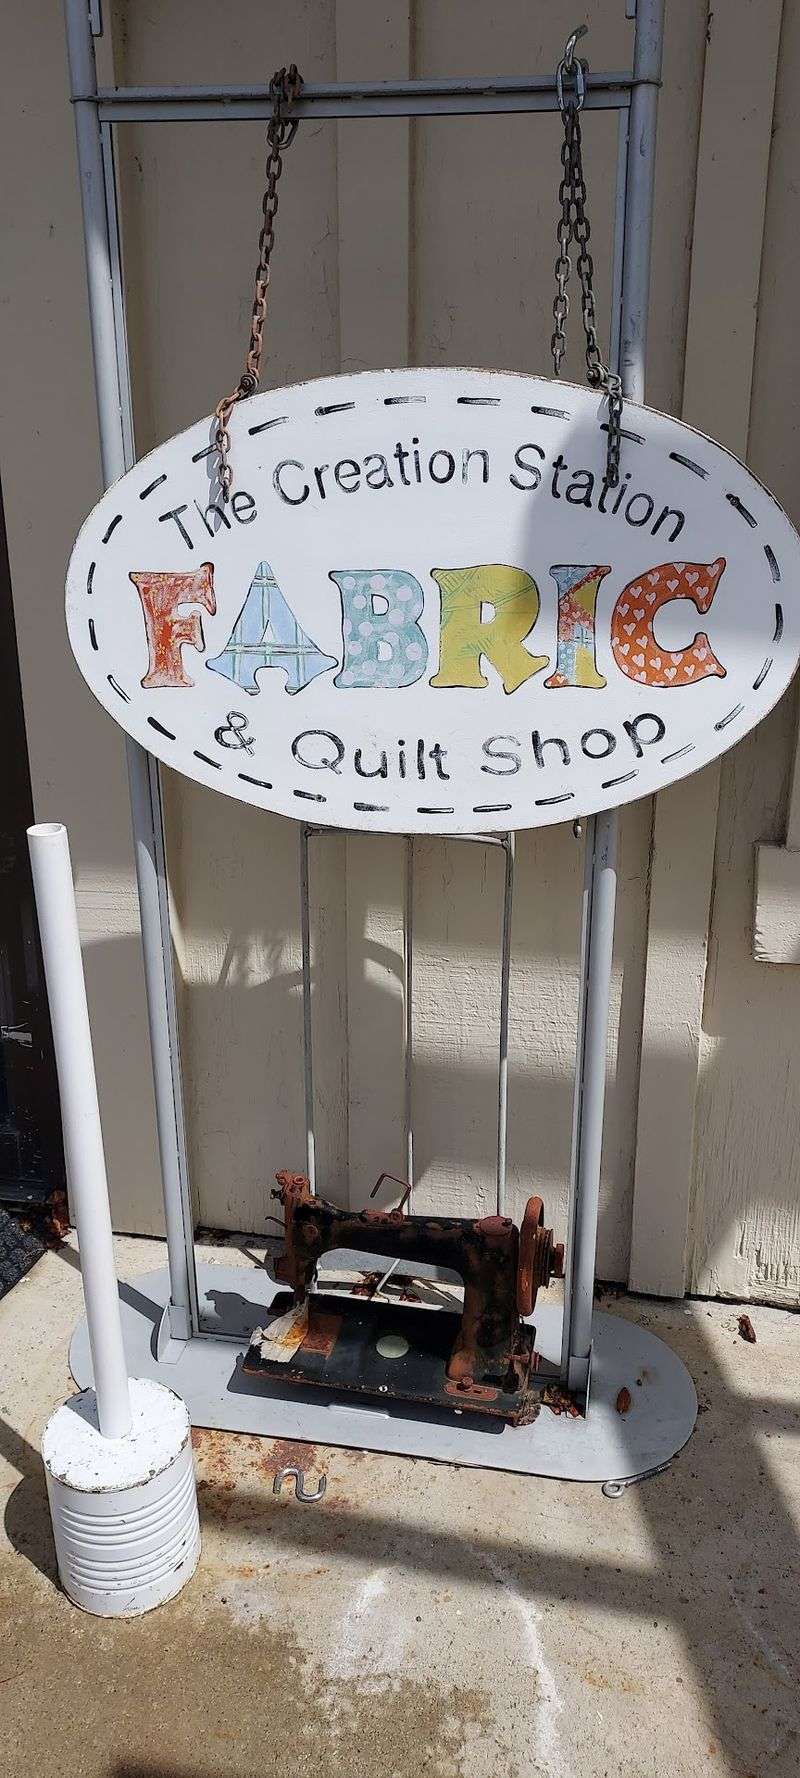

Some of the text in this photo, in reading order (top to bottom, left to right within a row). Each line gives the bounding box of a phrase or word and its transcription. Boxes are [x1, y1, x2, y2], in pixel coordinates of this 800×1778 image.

[158, 438, 686, 550] The Creation Station
[128, 558, 727, 696] FABRIC
[214, 710, 667, 780] & Quilt Shop
